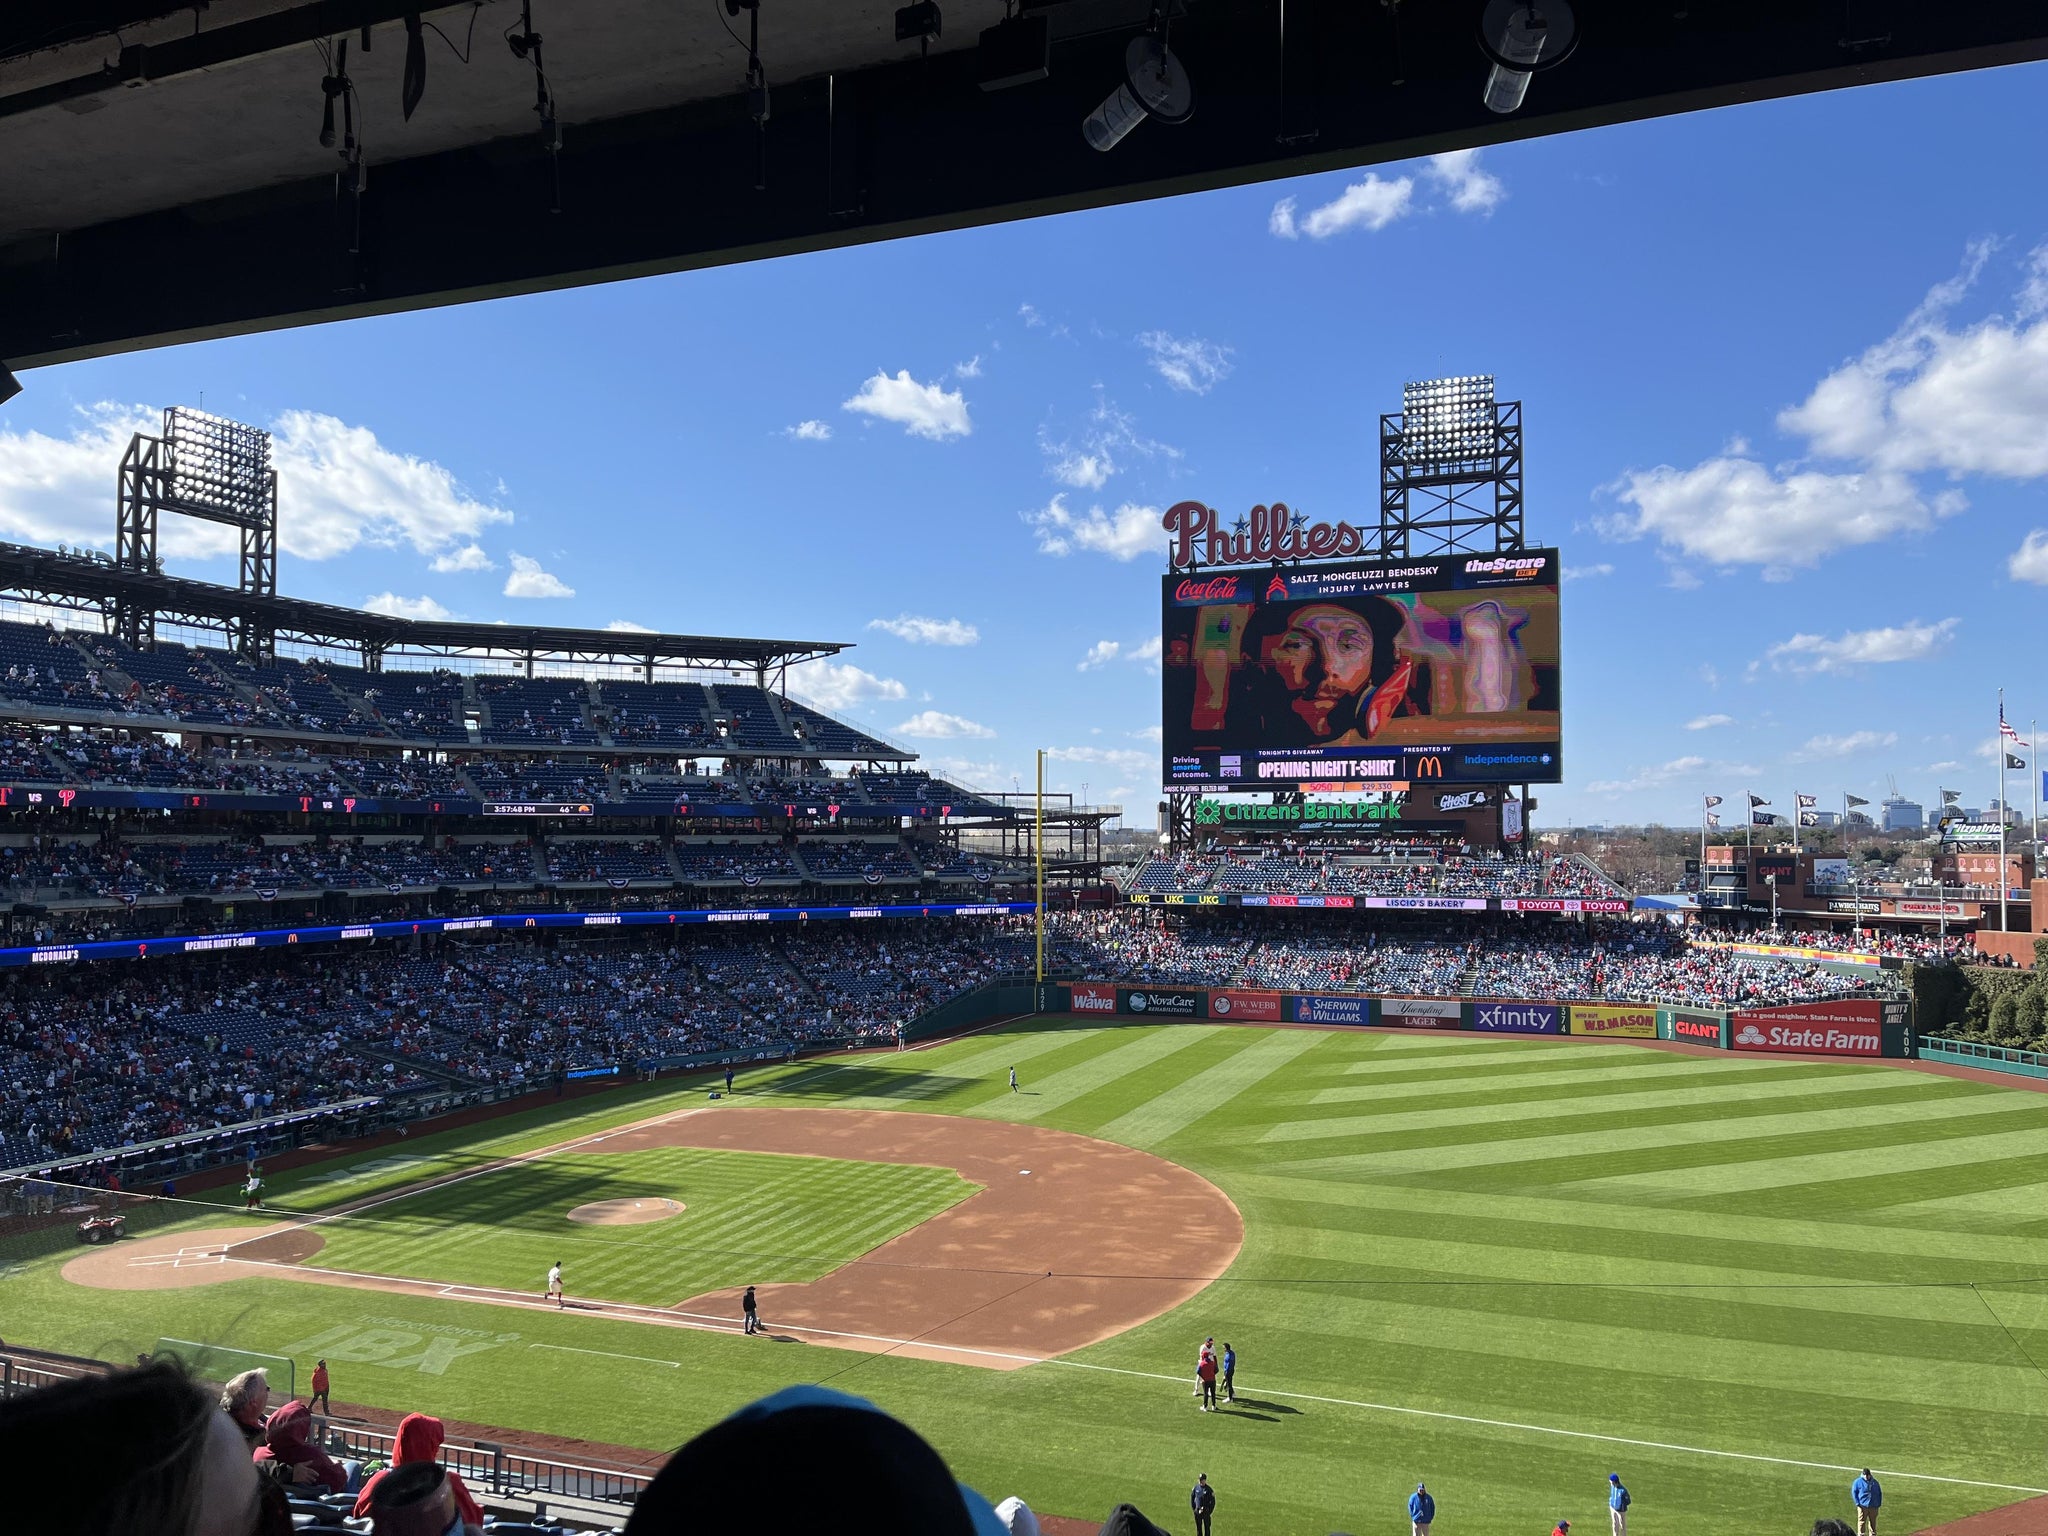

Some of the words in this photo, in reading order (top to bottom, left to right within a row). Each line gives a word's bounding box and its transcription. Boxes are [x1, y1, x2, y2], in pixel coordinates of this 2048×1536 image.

[1162, 500, 1362, 568] Phillies
[1465, 557, 1546, 573] theScore
[1290, 574, 1319, 584] SALTZ
[1322, 570, 1384, 582] MONGELUZZI
[1388, 566, 1439, 577] BENDESKY
[1319, 584, 1356, 593] INJURY
[1363, 581, 1410, 591] LAWYERS
[1172, 756, 1200, 764] Driving
[1464, 754, 1538, 766] Independence
[1258, 761, 1311, 778] OPENING
[1311, 760, 1349, 777] NIGHT
[1349, 759, 1396, 777] T-SHIRT
[1361, 783, 1393, 791] $29,330
[1440, 791, 1478, 811] GHOST
[494, 805, 523, 813] 3:57:48
[523, 805, 535, 813] PM
[1224, 802, 1300, 820] Citizens
[1304, 801, 1354, 819] Bank
[1357, 800, 1401, 819] Park
[1759, 866, 1792, 876] GIANT
[1130, 894, 1150, 903] UKG
[1164, 895, 1184, 904] UKG
[1199, 895, 1219, 904] UKG
[1271, 897, 1297, 905] NECA
[1327, 897, 1354, 906] NECA
[1385, 899, 1426, 907] LISCIO'S
[1427, 900, 1465, 908] BAKERY
[1521, 901, 1561, 910] TOYOTA
[1585, 902, 1626, 911] TOYOTA
[1748, 905, 1769, 913] Fanatics
[185, 939, 213, 950] OPENING
[213, 938, 232, 948] NIGHT
[232, 936, 256, 946] T-SHIRT
[32, 949, 79, 962] MCDONALD'S
[1073, 994, 1113, 1009] Wawa
[1147, 994, 1195, 1007] NovaCare
[1250, 1001, 1276, 1010] WEBB
[1313, 999, 1361, 1011] SHERWIN
[1396, 1001, 1446, 1015] Yuengling
[1885, 1003, 1908, 1014] MONTY'S
[1404, 1017, 1437, 1026] LAGER
[1479, 1006, 1552, 1029] xfinity
[1759, 1012, 1775, 1020] good
[1776, 1012, 1808, 1021] neighbor,
[1829, 1014, 1848, 1022] Farm
[1886, 1014, 1904, 1024] ANGLE
[1675, 1021, 1719, 1039] GIANT
[567, 1067, 611, 1079] Independence
[356, 1314, 494, 1339] Independence
